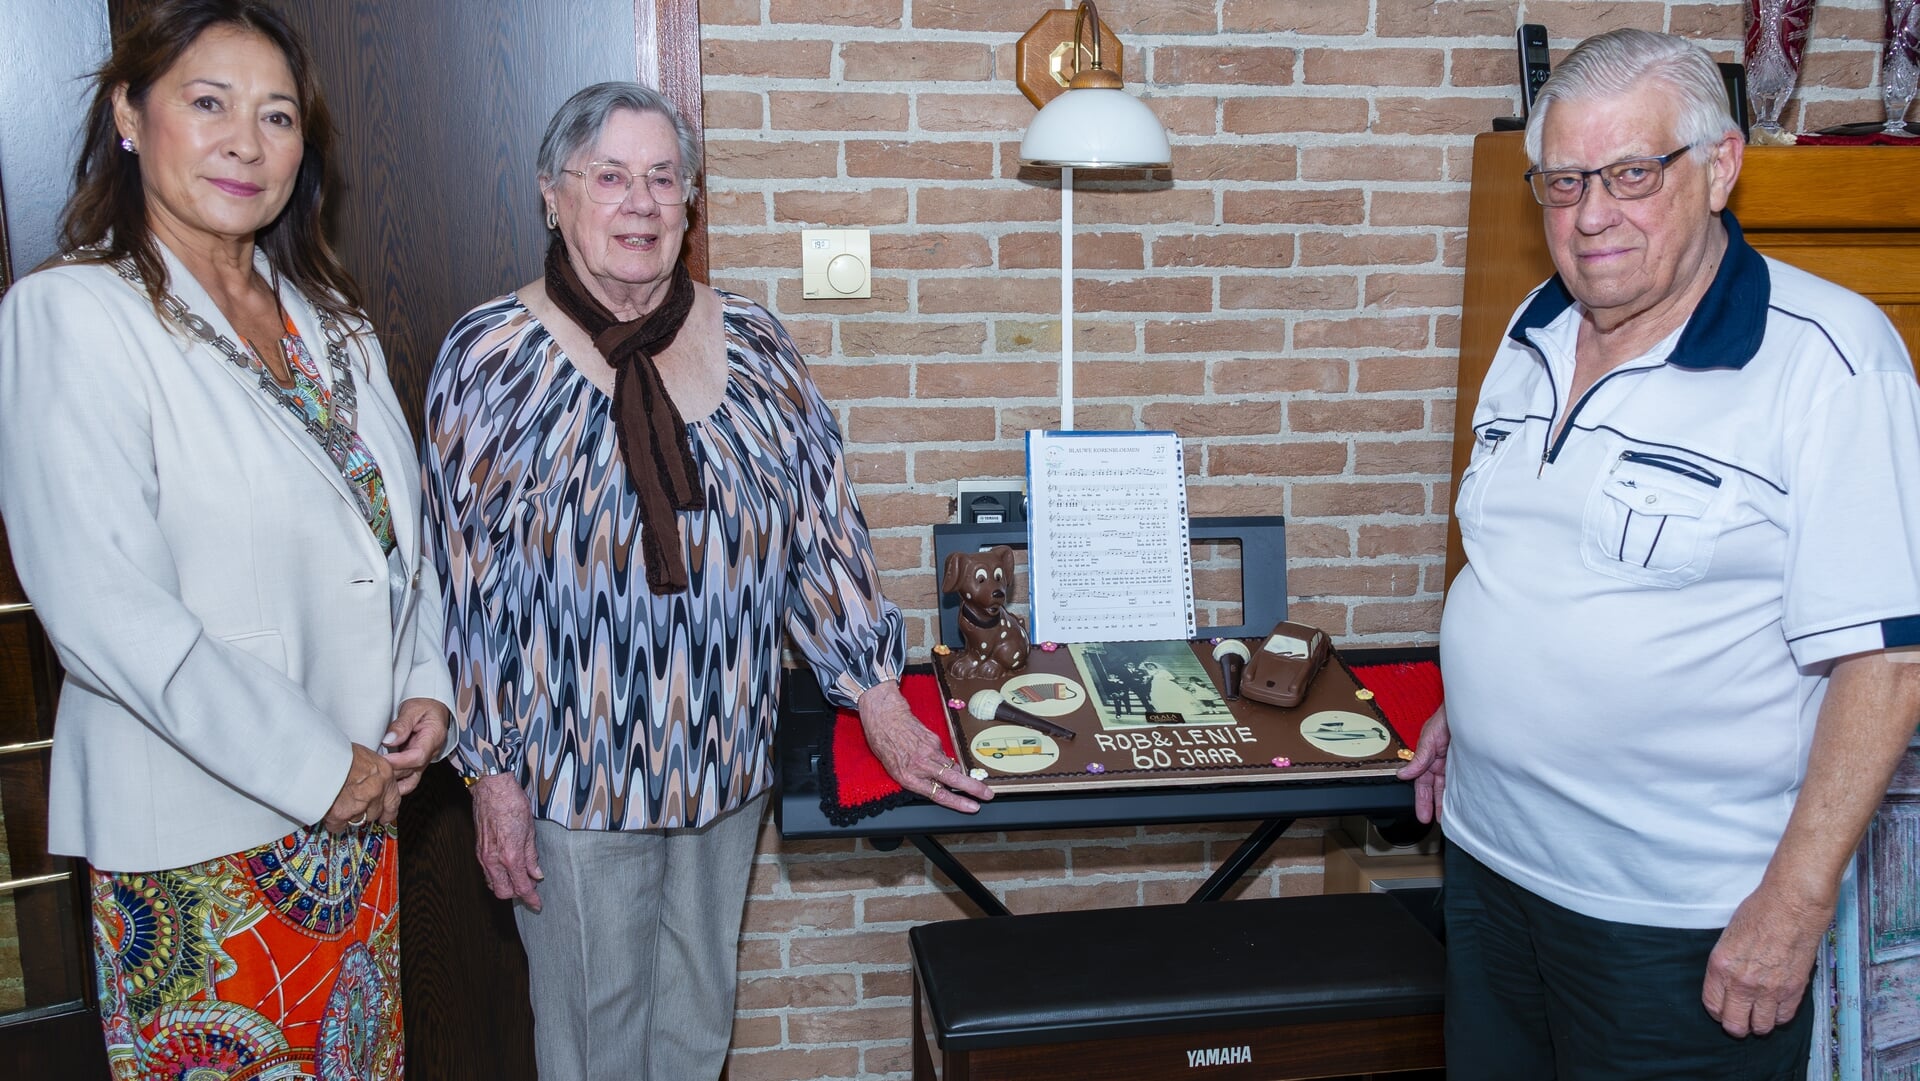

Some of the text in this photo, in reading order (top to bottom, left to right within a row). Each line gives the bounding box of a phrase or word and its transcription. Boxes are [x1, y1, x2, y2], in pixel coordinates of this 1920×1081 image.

[1156, 446, 1165, 454] 27
[1131, 747, 1244, 769] 60 JAAR
[1187, 1045, 1252, 1068] YAMAHA
